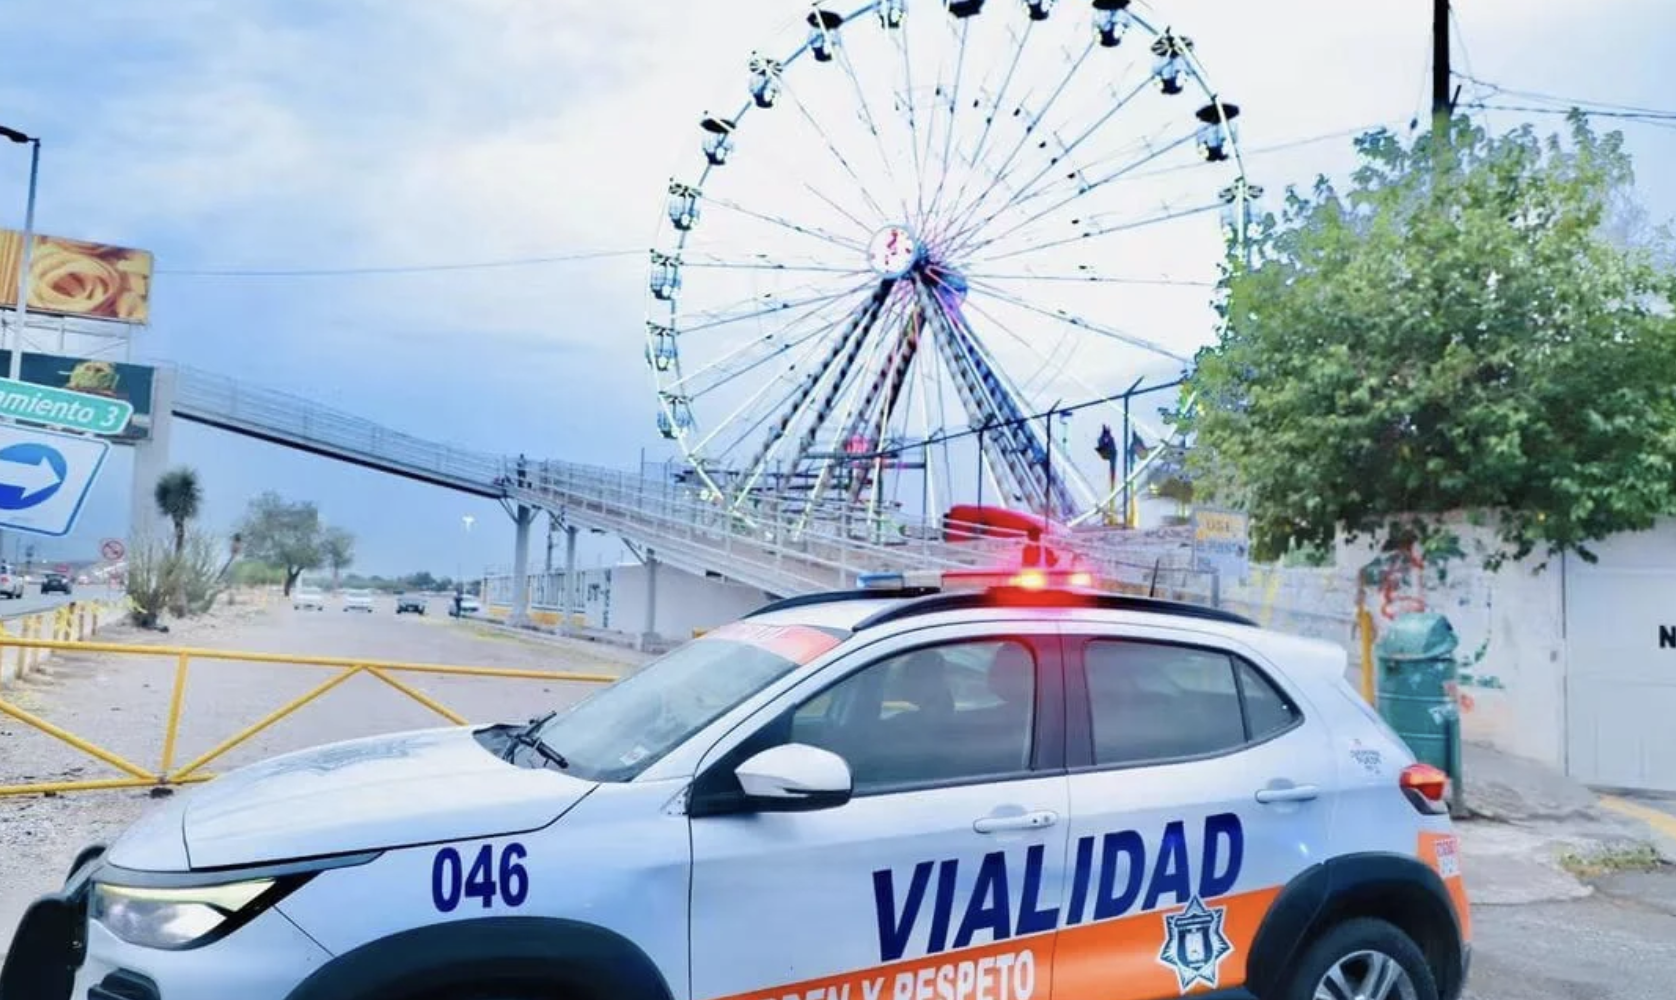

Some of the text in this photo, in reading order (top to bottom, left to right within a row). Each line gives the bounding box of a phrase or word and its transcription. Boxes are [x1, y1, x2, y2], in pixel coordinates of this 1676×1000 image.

[0, 391, 119, 427] miento 3
[431, 842, 529, 913] 046
[872, 812, 1244, 962] VIALIDAD
[893, 949, 1035, 1000] RESPETO
